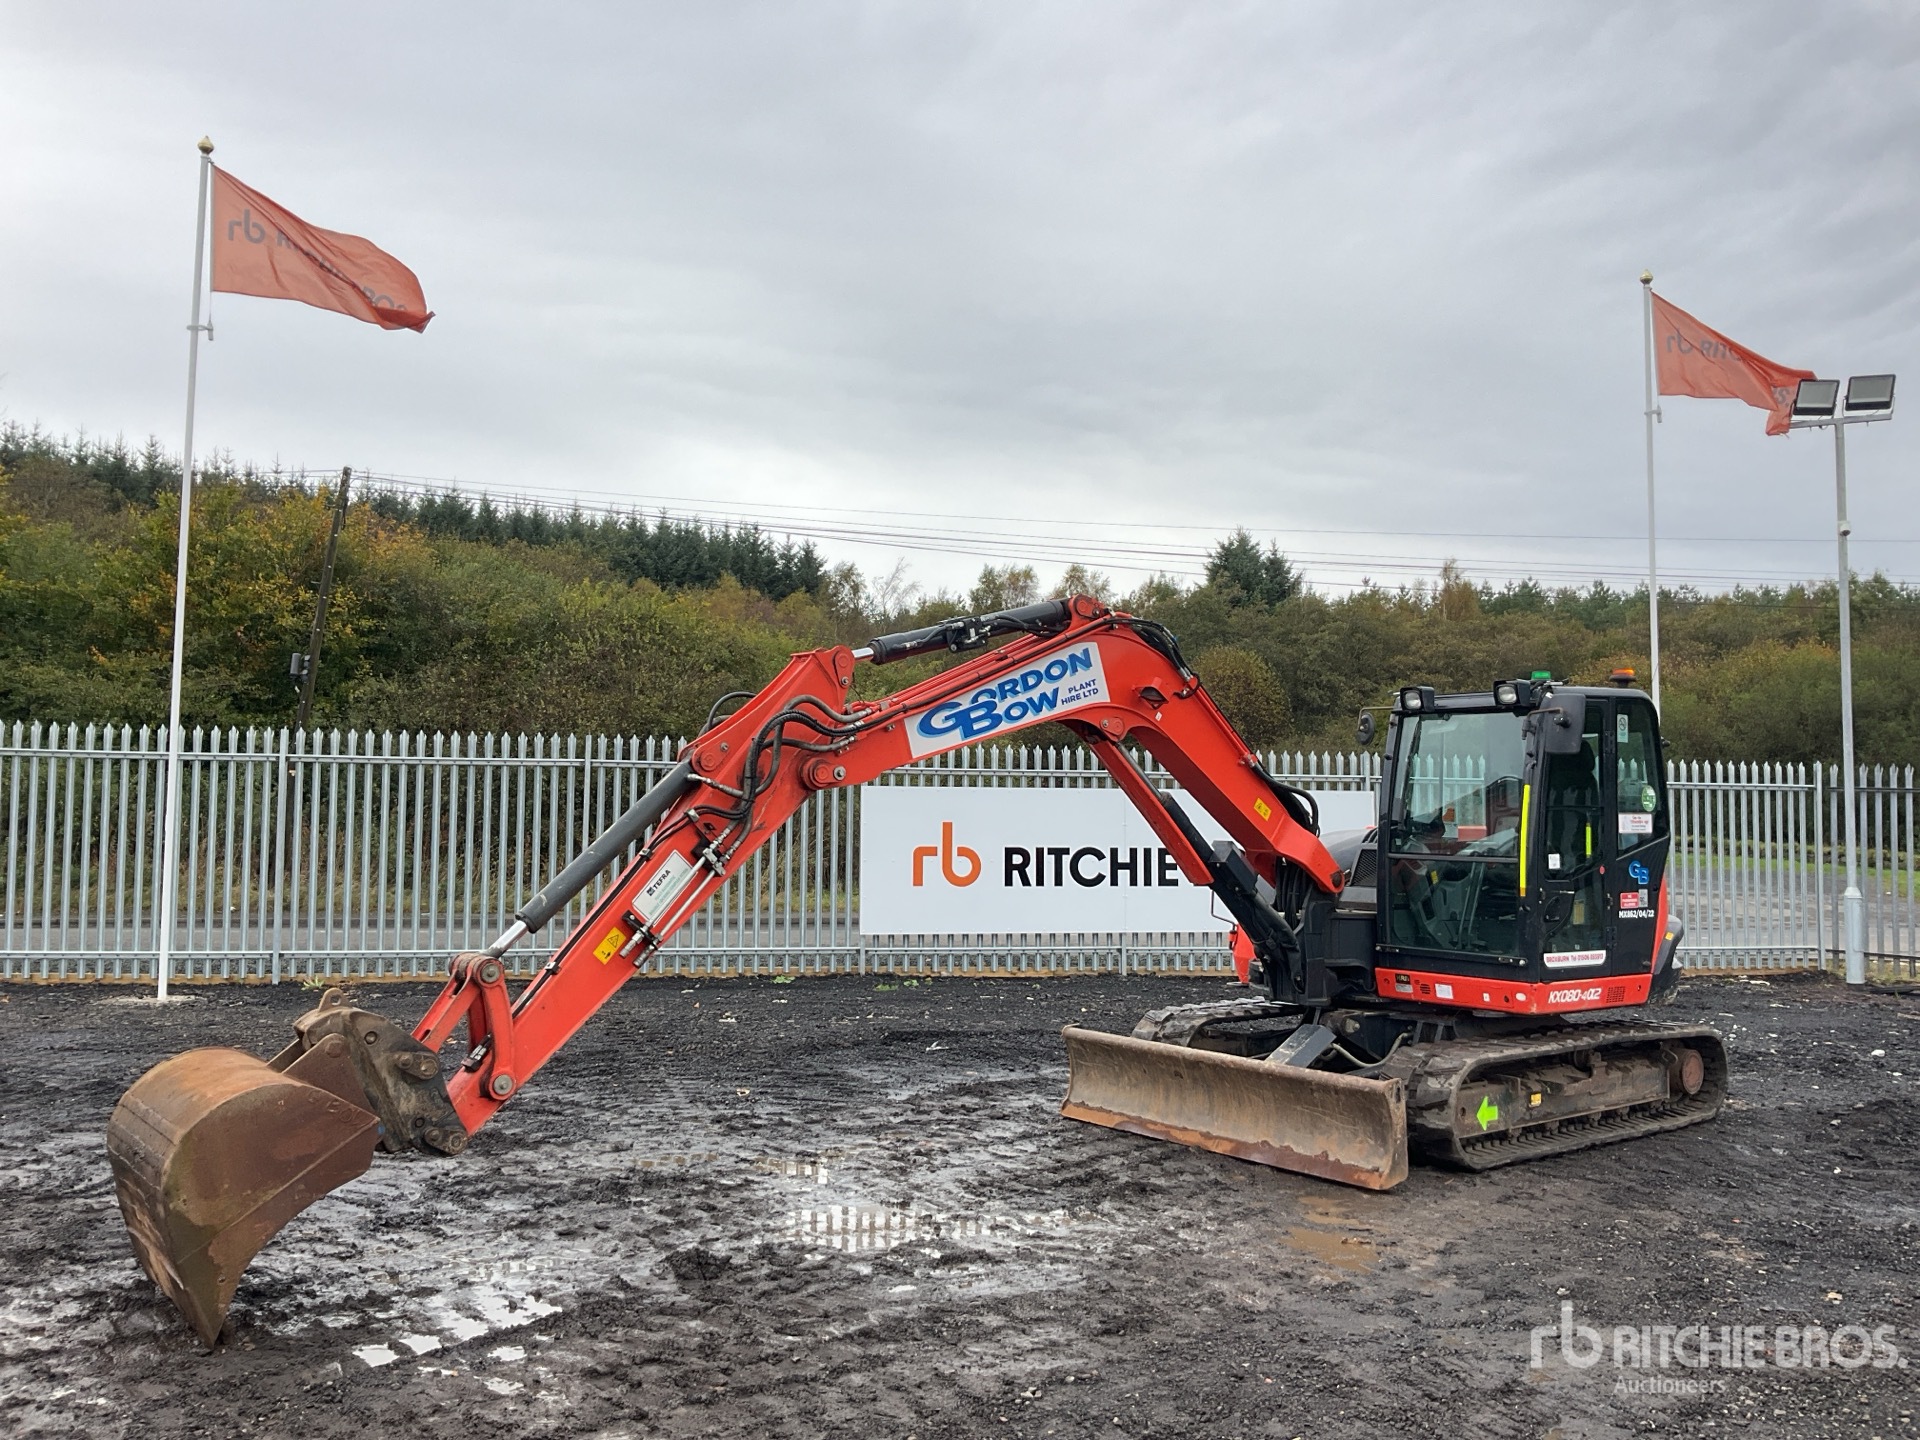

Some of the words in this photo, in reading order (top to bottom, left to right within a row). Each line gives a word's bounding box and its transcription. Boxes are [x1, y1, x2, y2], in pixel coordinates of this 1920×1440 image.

[228, 209, 265, 244] rb
[917, 647, 1093, 738] GORDON
[1061, 692, 1082, 706] HIRE
[1083, 687, 1099, 699] LTD
[1068, 679, 1097, 694] PLANT
[957, 687, 1060, 741] BOW
[912, 821, 982, 887] rb
[1004, 846, 1179, 887] RITCHIE
[653, 869, 671, 890] TEFRA
[1628, 861, 1650, 885] GB
